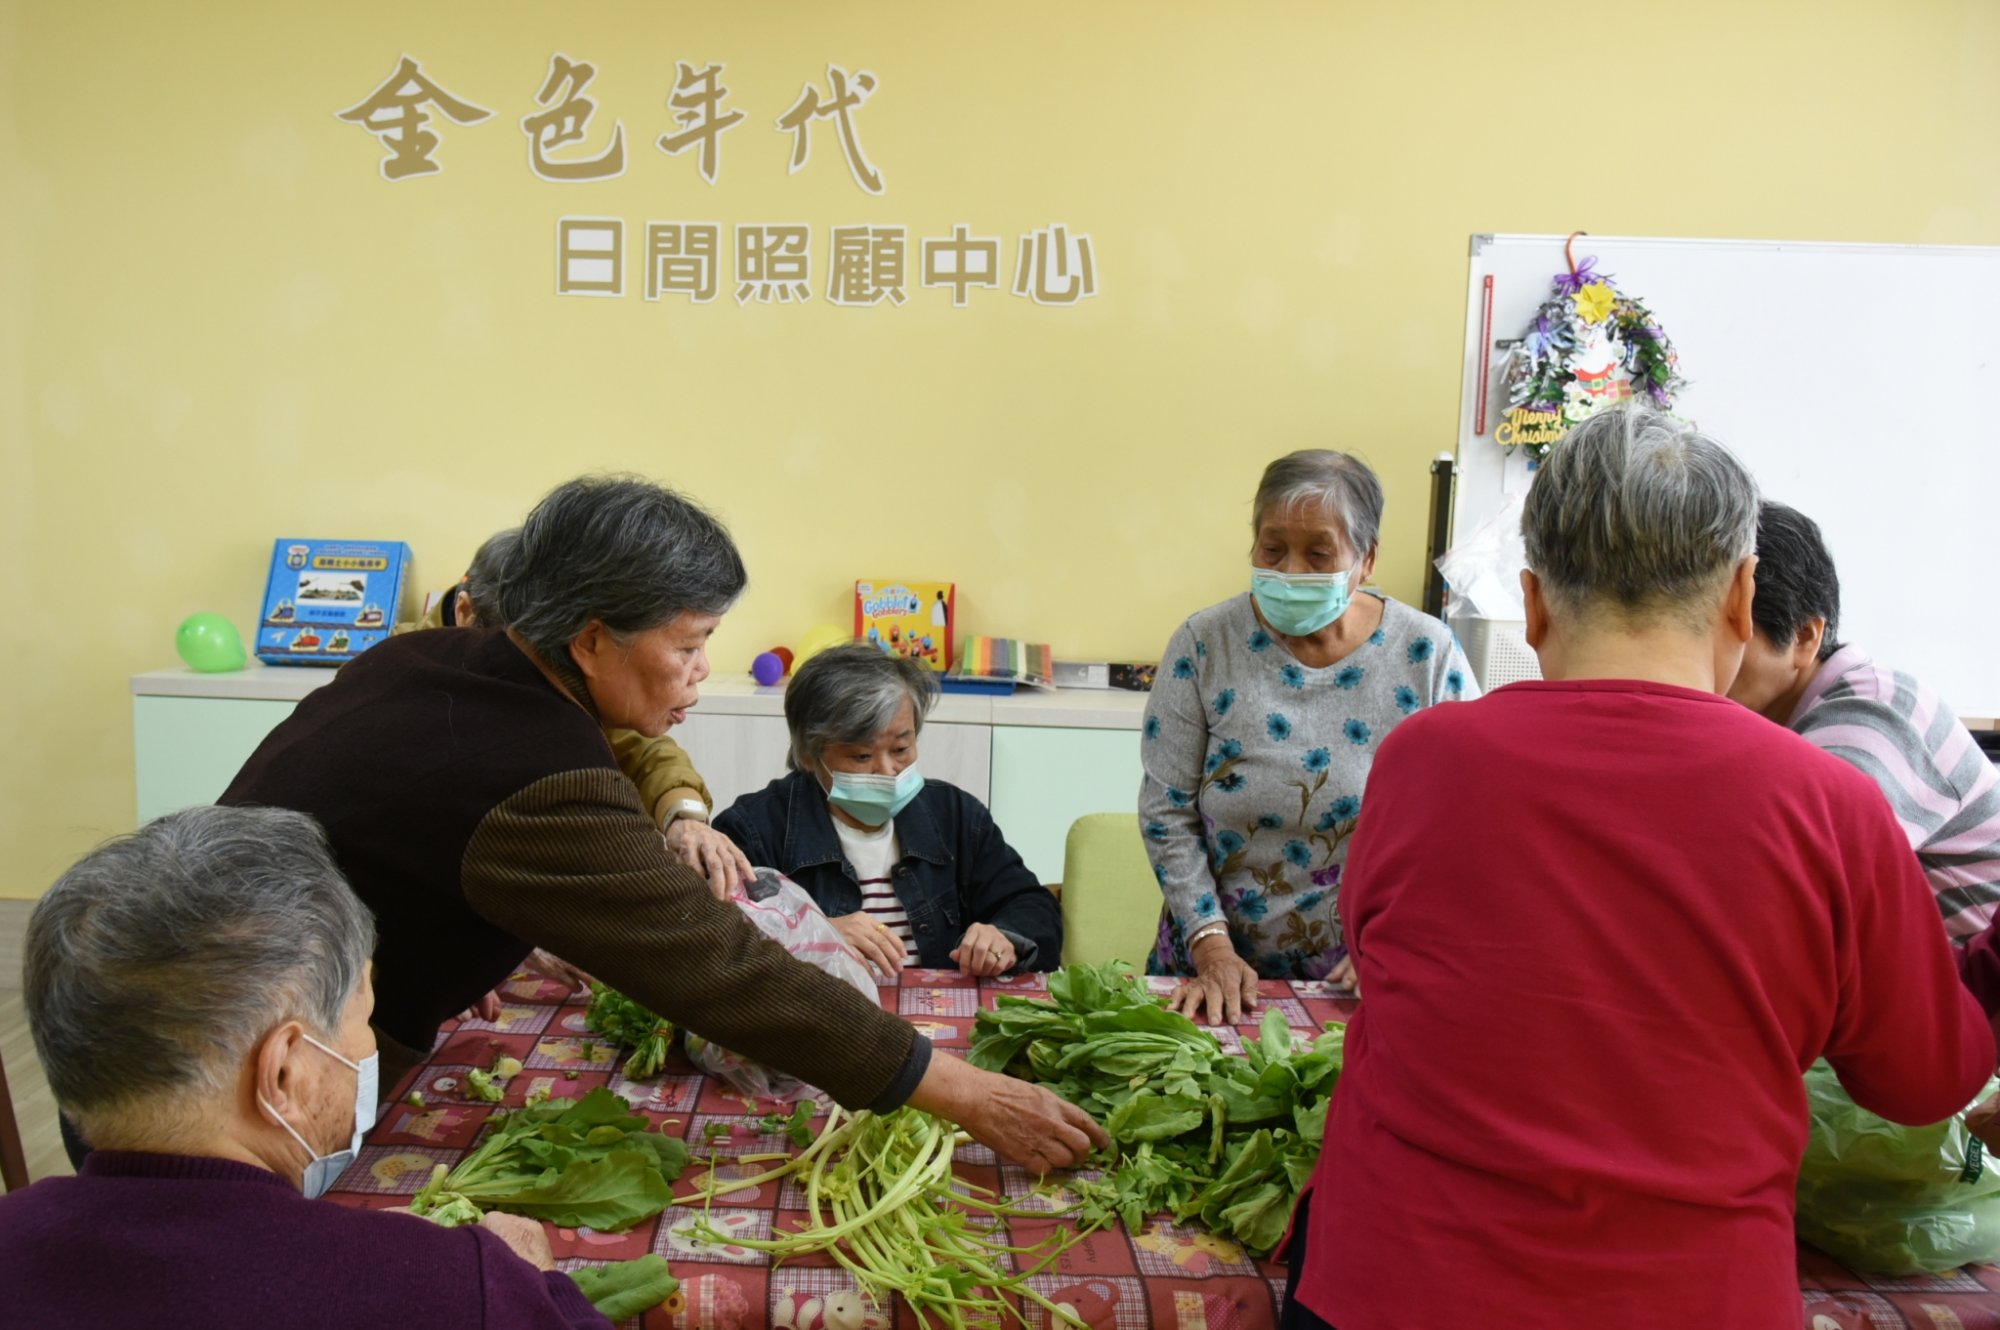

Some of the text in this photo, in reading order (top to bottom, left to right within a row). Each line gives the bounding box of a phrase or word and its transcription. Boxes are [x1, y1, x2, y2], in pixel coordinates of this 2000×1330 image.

[335, 54, 885, 196] 金色年代
[555, 216, 1098, 307] 日間照顧中心
[1503, 406, 1562, 428] Merry
